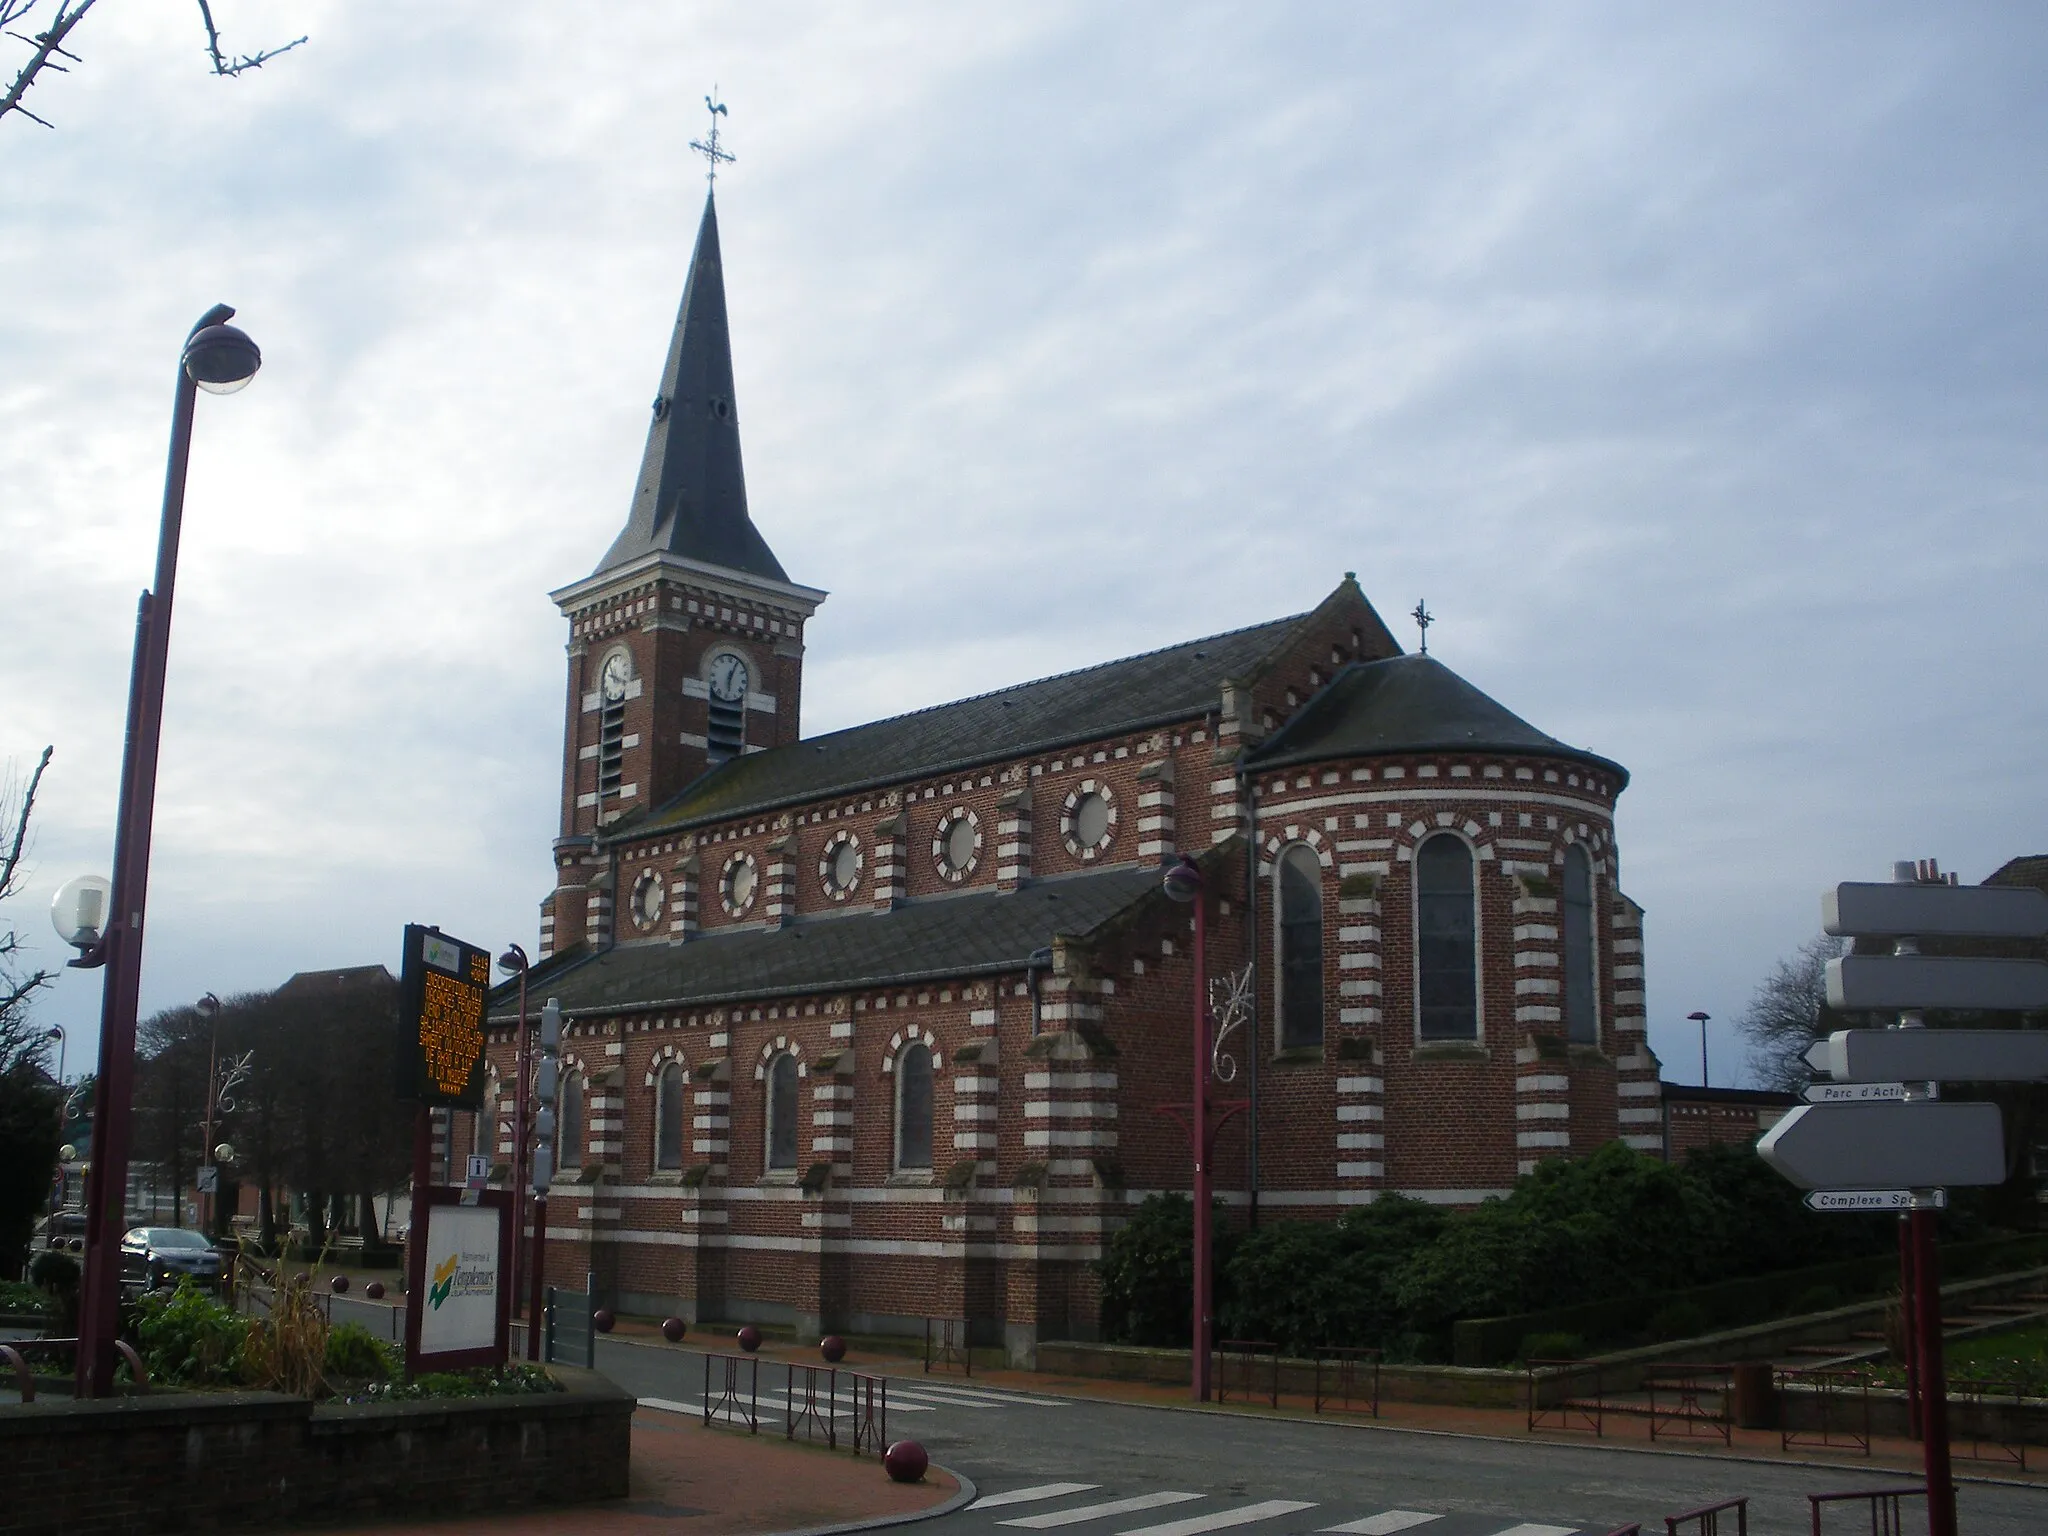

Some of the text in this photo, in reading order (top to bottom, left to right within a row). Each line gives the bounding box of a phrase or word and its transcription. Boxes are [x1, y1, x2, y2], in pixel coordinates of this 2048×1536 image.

[1825, 1088, 1852, 1098] Parc
[1821, 1195, 1882, 1207] Complexe
[453, 1266, 494, 1289] Templemars
